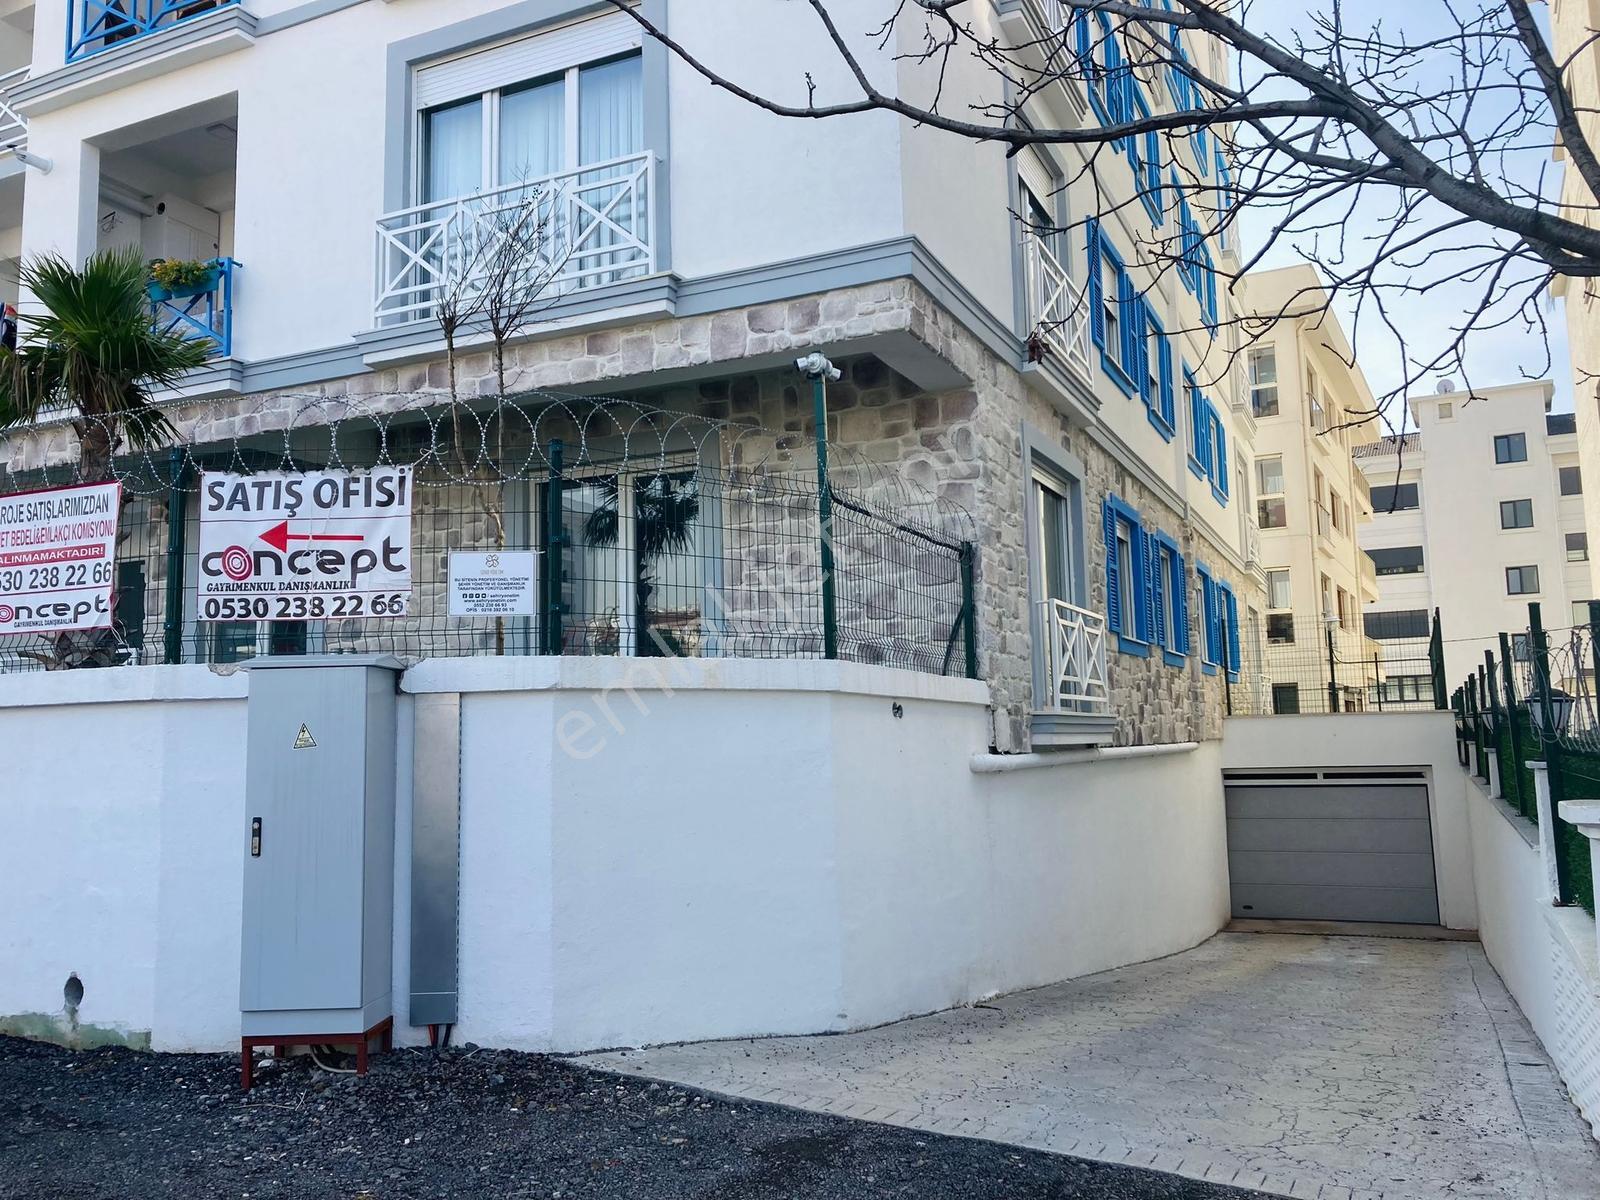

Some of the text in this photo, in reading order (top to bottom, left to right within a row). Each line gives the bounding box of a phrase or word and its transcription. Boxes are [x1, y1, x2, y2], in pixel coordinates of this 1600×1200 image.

[26, 493, 109, 524] SATIŞLARIMIZDAN
[208, 480, 304, 517] SATIŞ
[72, 518, 115, 541] KOMİSYONU
[0, 561, 112, 592] 30 238 22 66
[202, 535, 407, 588] concept
[205, 593, 404, 619] 0530 238 22 66
